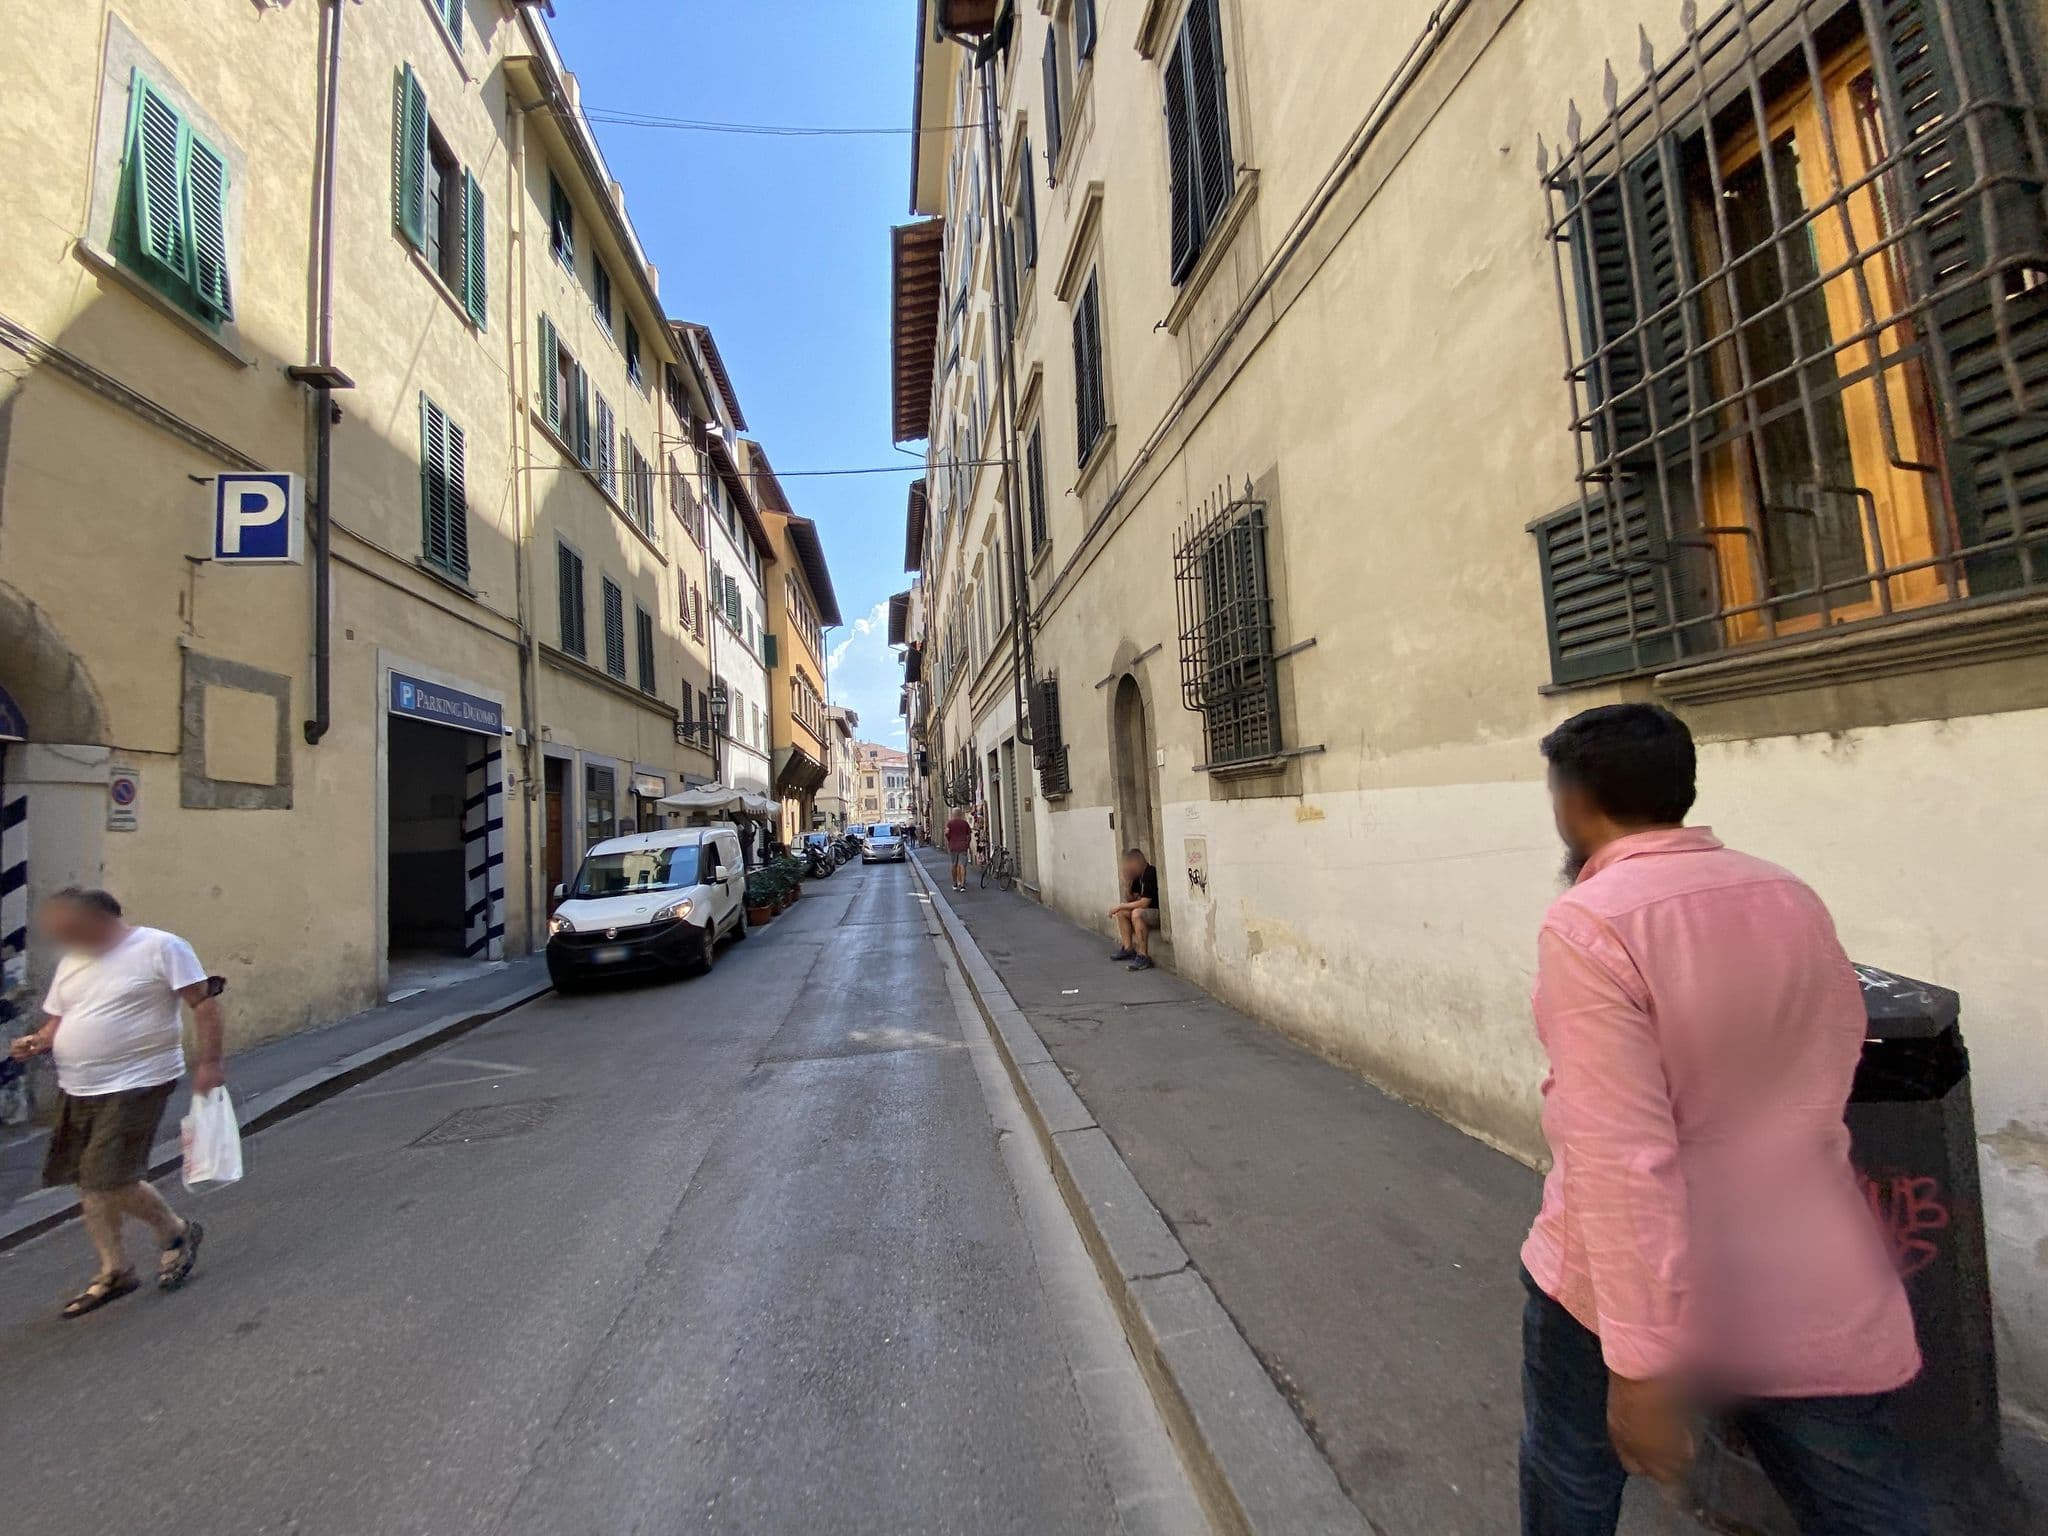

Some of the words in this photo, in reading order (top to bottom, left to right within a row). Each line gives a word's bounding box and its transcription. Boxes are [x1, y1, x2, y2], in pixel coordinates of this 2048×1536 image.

[222, 481, 286, 553] P
[402, 684, 412, 705] P
[416, 689, 462, 718] PARKING
